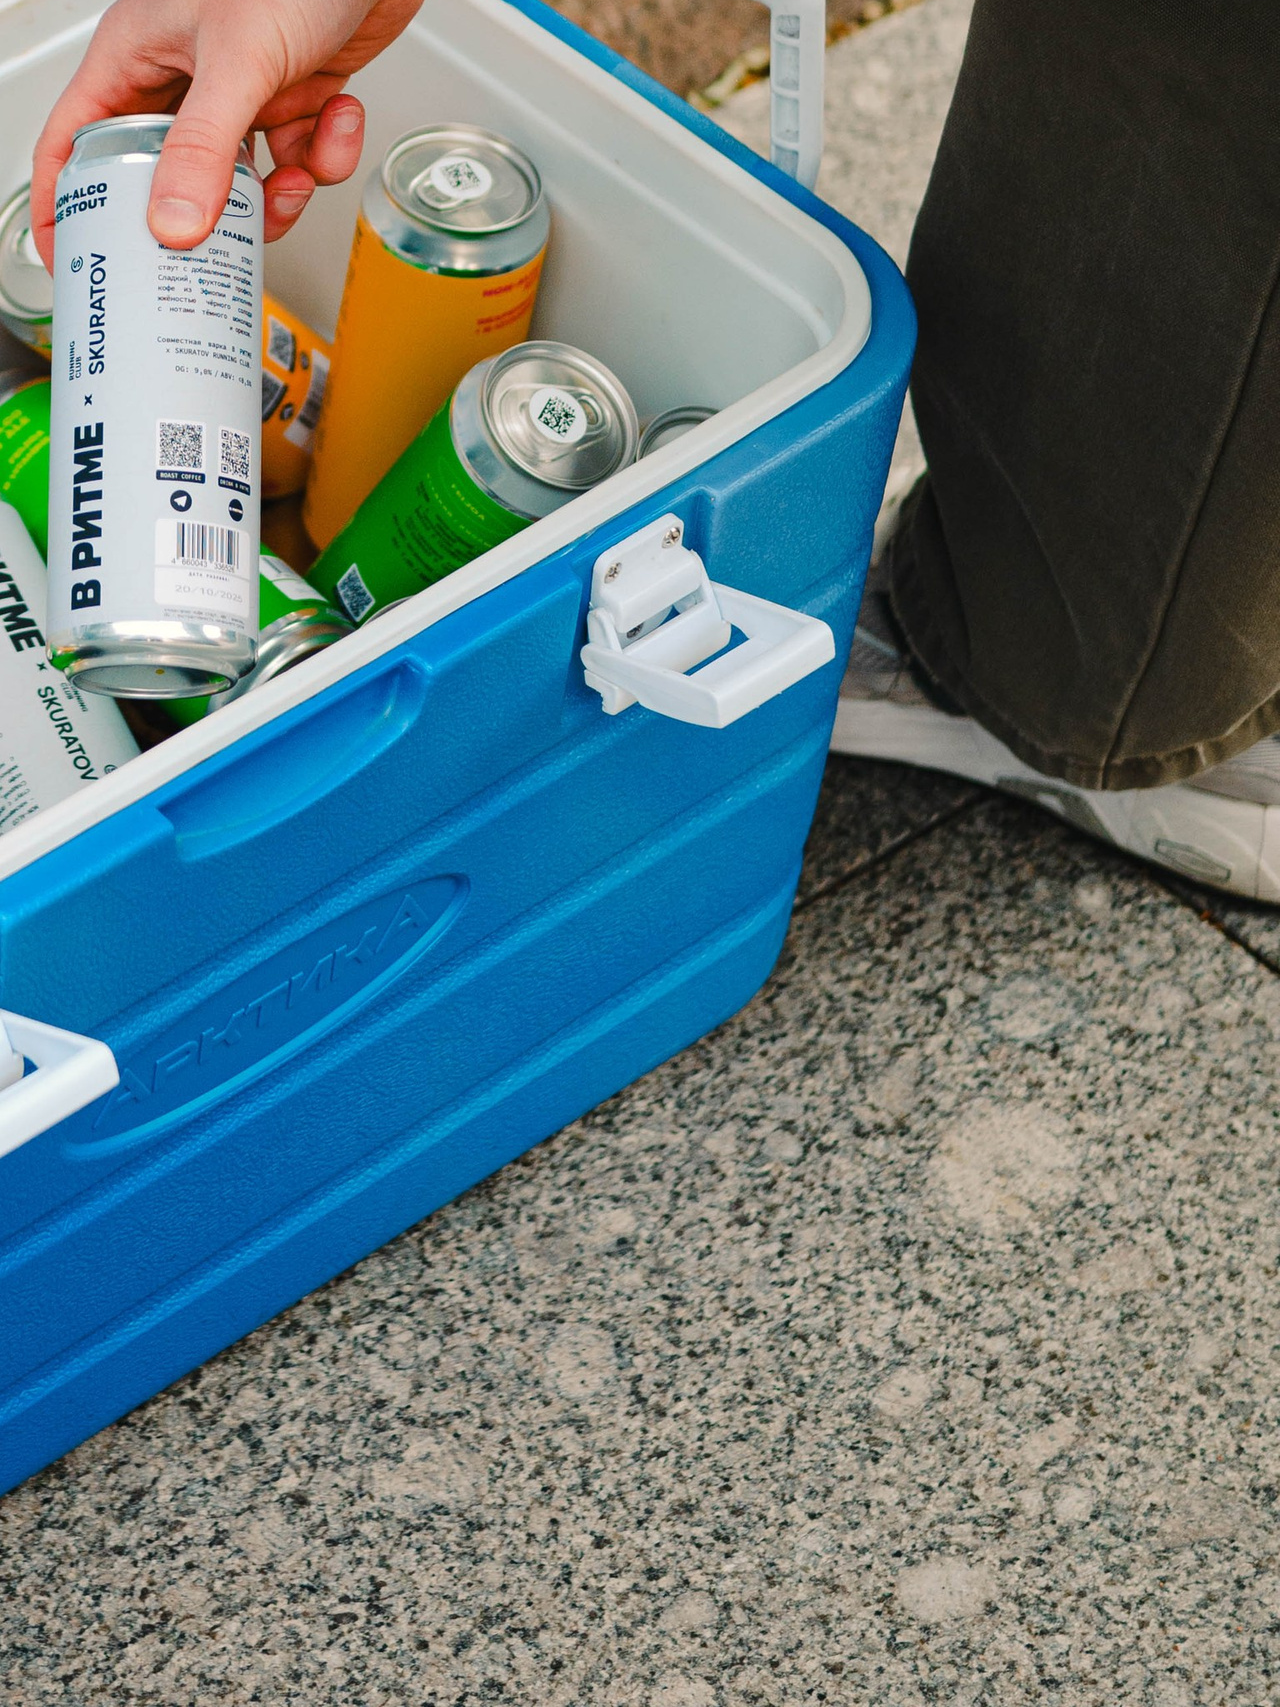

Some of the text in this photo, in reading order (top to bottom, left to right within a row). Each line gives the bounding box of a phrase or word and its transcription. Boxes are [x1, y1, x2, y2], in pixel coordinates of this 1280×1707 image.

[65, 196, 107, 217] STOUT
[226, 197, 249, 211] TOUT
[208, 247, 230, 258] COFFEE
[88, 253, 106, 375] SKURATOV
[175, 347, 210, 357] SKURATOV
[213, 352, 238, 363] RUNNING
[72, 422, 104, 571] РИТМЕ
[37, 686, 99, 781] SKURATOV
